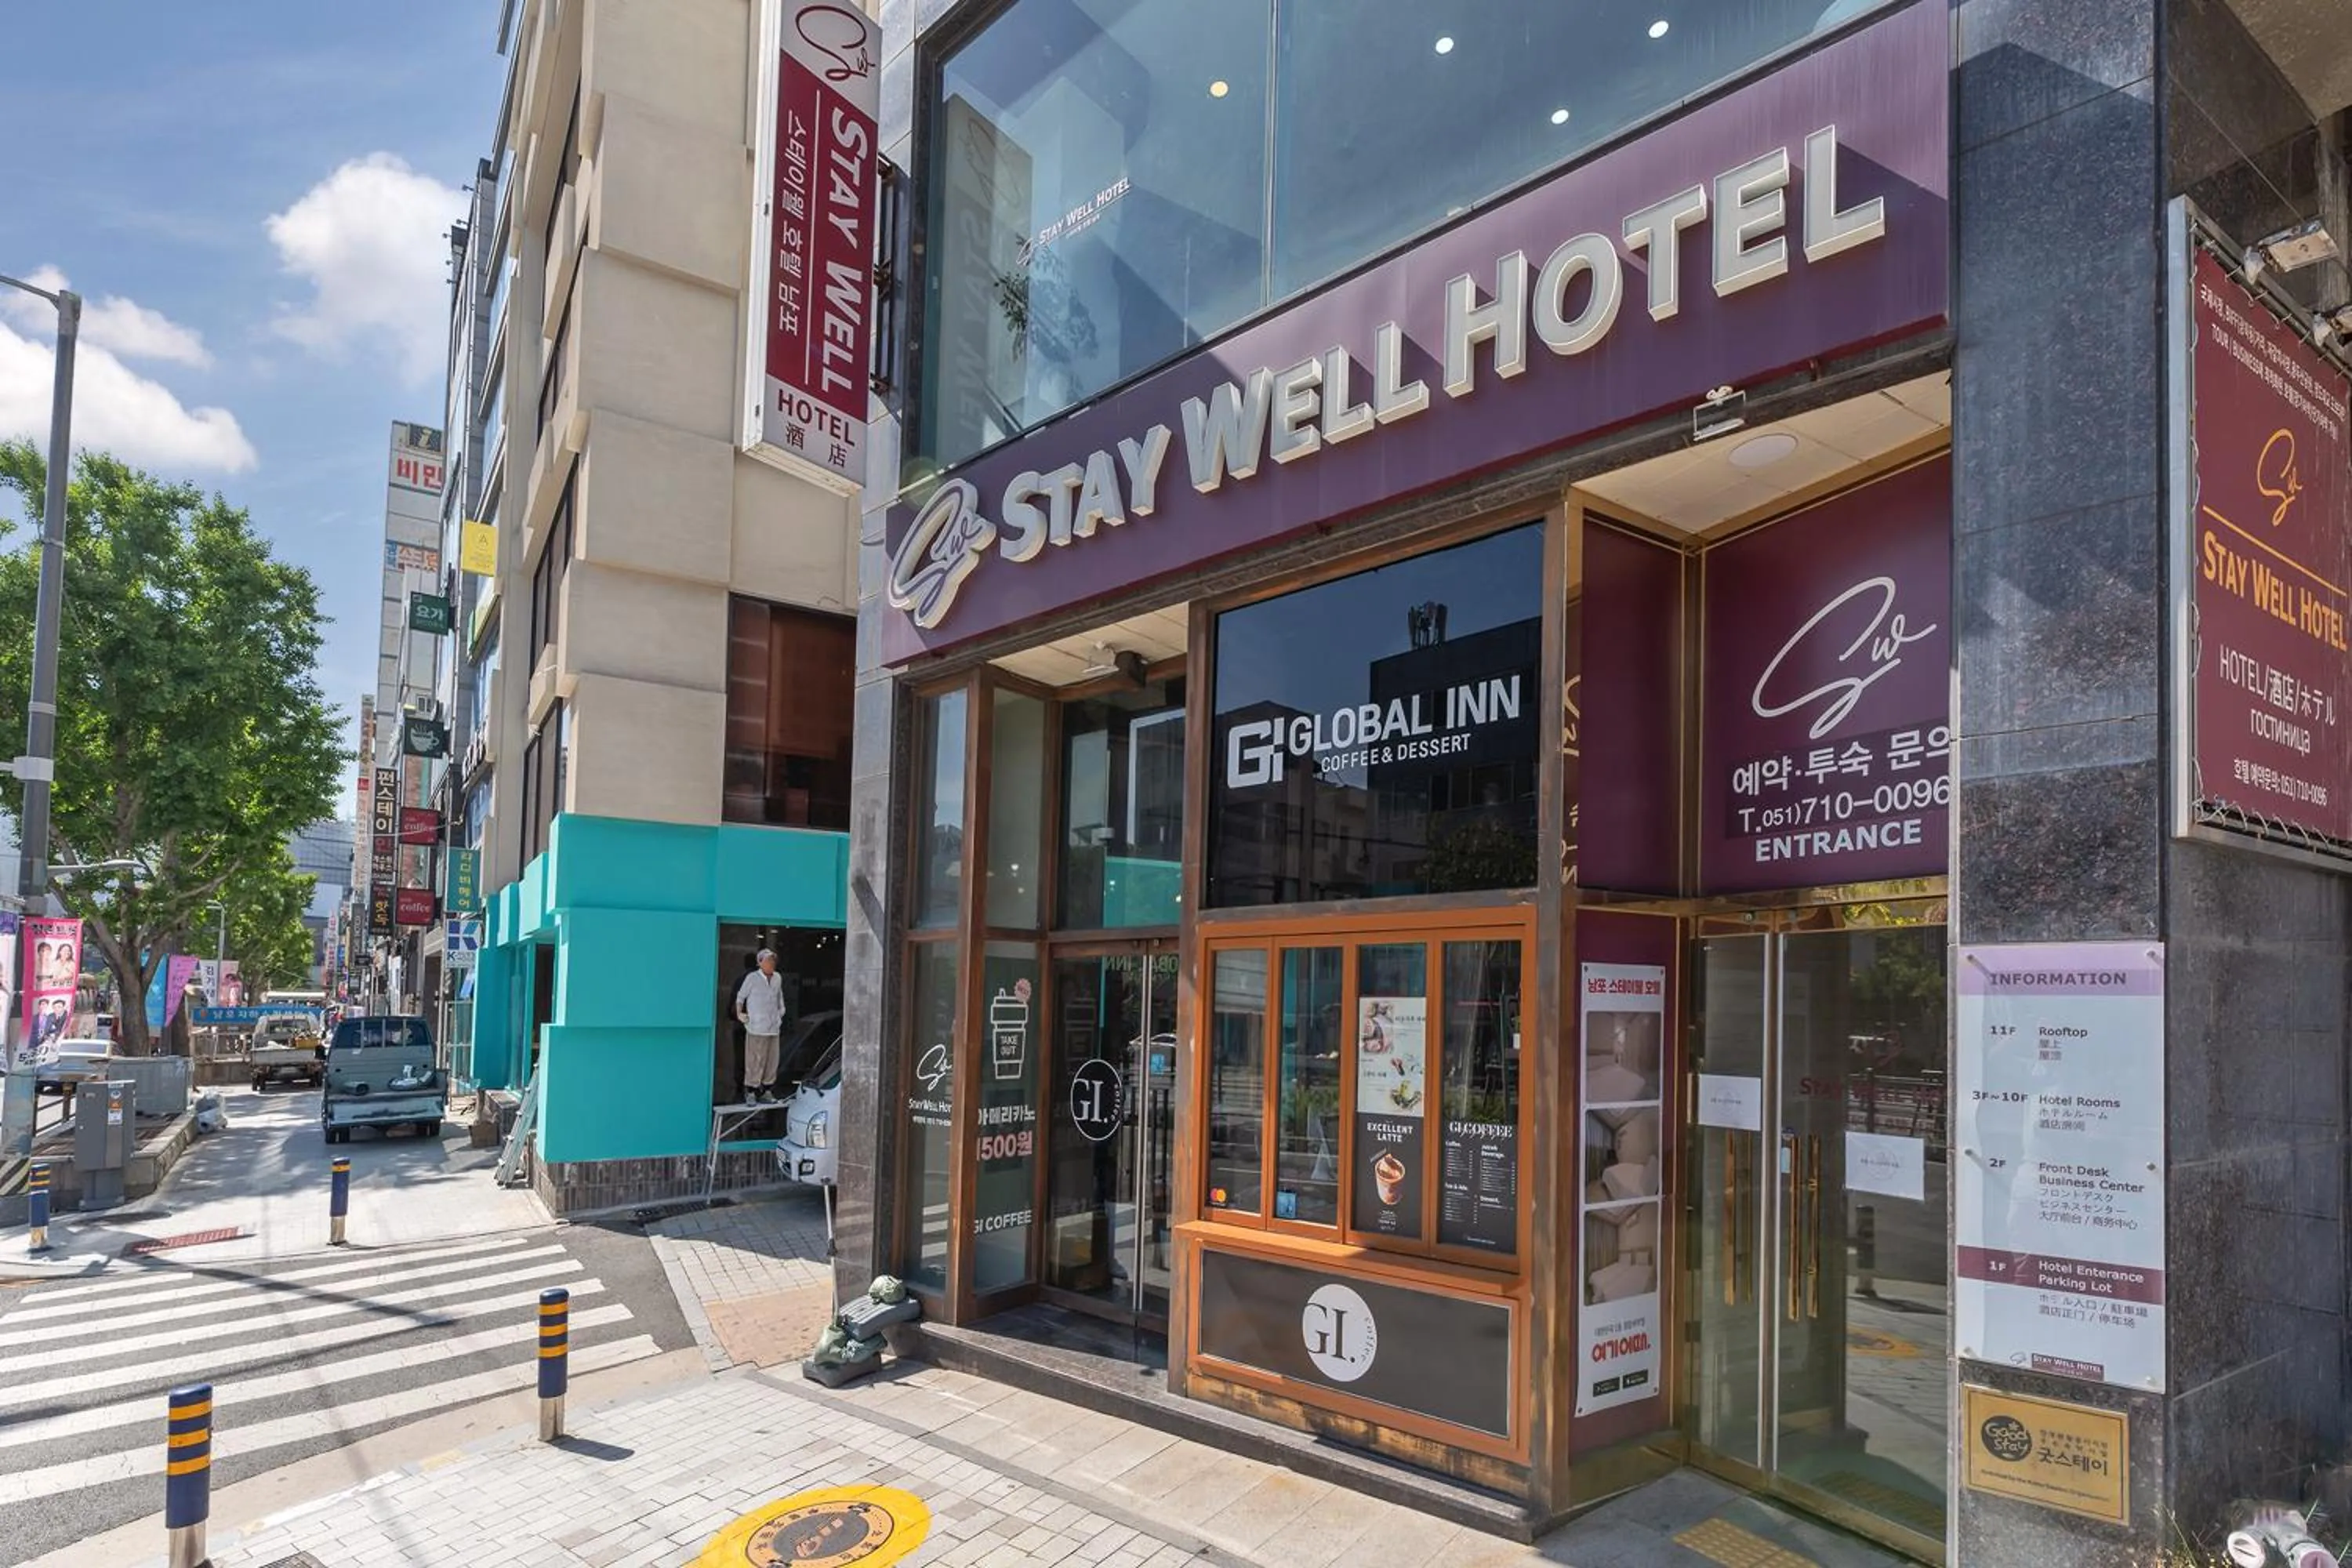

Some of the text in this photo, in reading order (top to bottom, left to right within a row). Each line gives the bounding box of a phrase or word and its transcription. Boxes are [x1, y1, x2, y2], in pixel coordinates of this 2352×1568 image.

[1040, 220, 1064, 245] STAY
[1065, 201, 1094, 227] WELL
[1096, 176, 1131, 207] HOTEL
[779, 110, 807, 336] 스테이웰 호텔 남포
[822, 107, 869, 392] STAY WELL
[1000, 424, 1172, 563] STAY
[1180, 321, 1429, 494] WELL
[1443, 124, 1885, 398] HOTEL
[778, 389, 855, 447] HOTEL
[2203, 530, 2348, 652] STAY WELL HOTEL
[1288, 695, 1432, 757] GLOBAL
[1446, 675, 1520, 729] INN
[1397, 733, 1472, 760] DESSERT
[2234, 757, 2249, 784] 호텔
[1755, 818, 1922, 862] ENTRANCE
[1990, 972, 2127, 985] INFORMATION
[1000, 1035, 1018, 1046] TAKE
[1991, 1025, 2089, 1039] 11F Rooftop
[1000, 1046, 1017, 1057] OUT
[938, 1101, 952, 1113] HOT
[2038, 1094, 2072, 1106] Hotel
[2077, 1097, 2121, 1108] Rooms
[978, 1105, 1036, 1127] 아메리카노
[1367, 1122, 1414, 1134] EXCELLENT
[1377, 1133, 1403, 1142] LATTE
[1989, 1159, 2110, 1178] 2F Front Desk
[2038, 1175, 2145, 1193] Business Center
[985, 1210, 1033, 1232] COFFEE
[1989, 1260, 2145, 1283] 1F Hotel Enterance
[2038, 1275, 2113, 1294] Parking Lot
[1985, 1423, 2028, 1441] Good
[1994, 1438, 2029, 1455] Stay
[2037, 1446, 2108, 1476] 굿스테이
